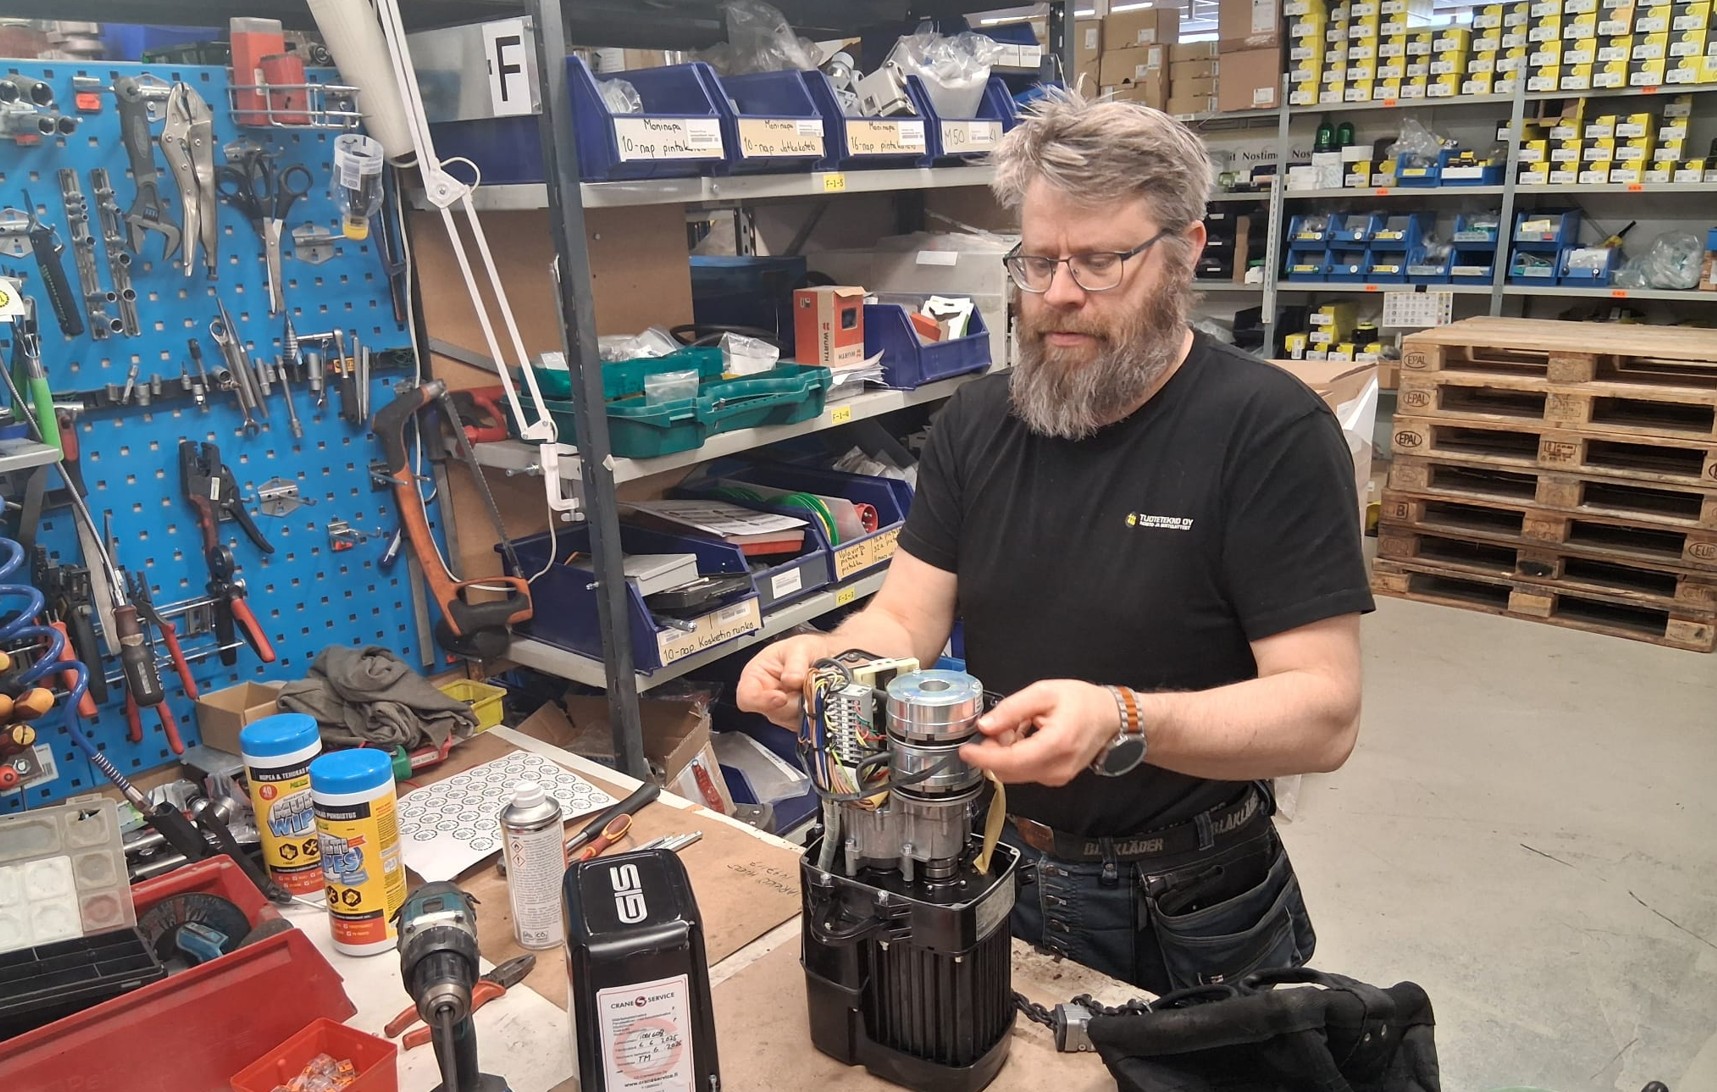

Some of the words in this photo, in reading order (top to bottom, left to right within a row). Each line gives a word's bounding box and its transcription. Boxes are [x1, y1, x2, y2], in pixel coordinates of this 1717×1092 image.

[495, 35, 521, 102] F
[622, 136, 655, 157] 10-nap
[1242, 150, 1278, 161] Nostim
[1399, 433, 1418, 446] EPAL
[268, 808, 315, 838] WIP
[322, 849, 362, 874] PES
[611, 1001, 634, 1009] CRANE
[648, 992, 675, 1003] SERVICE
